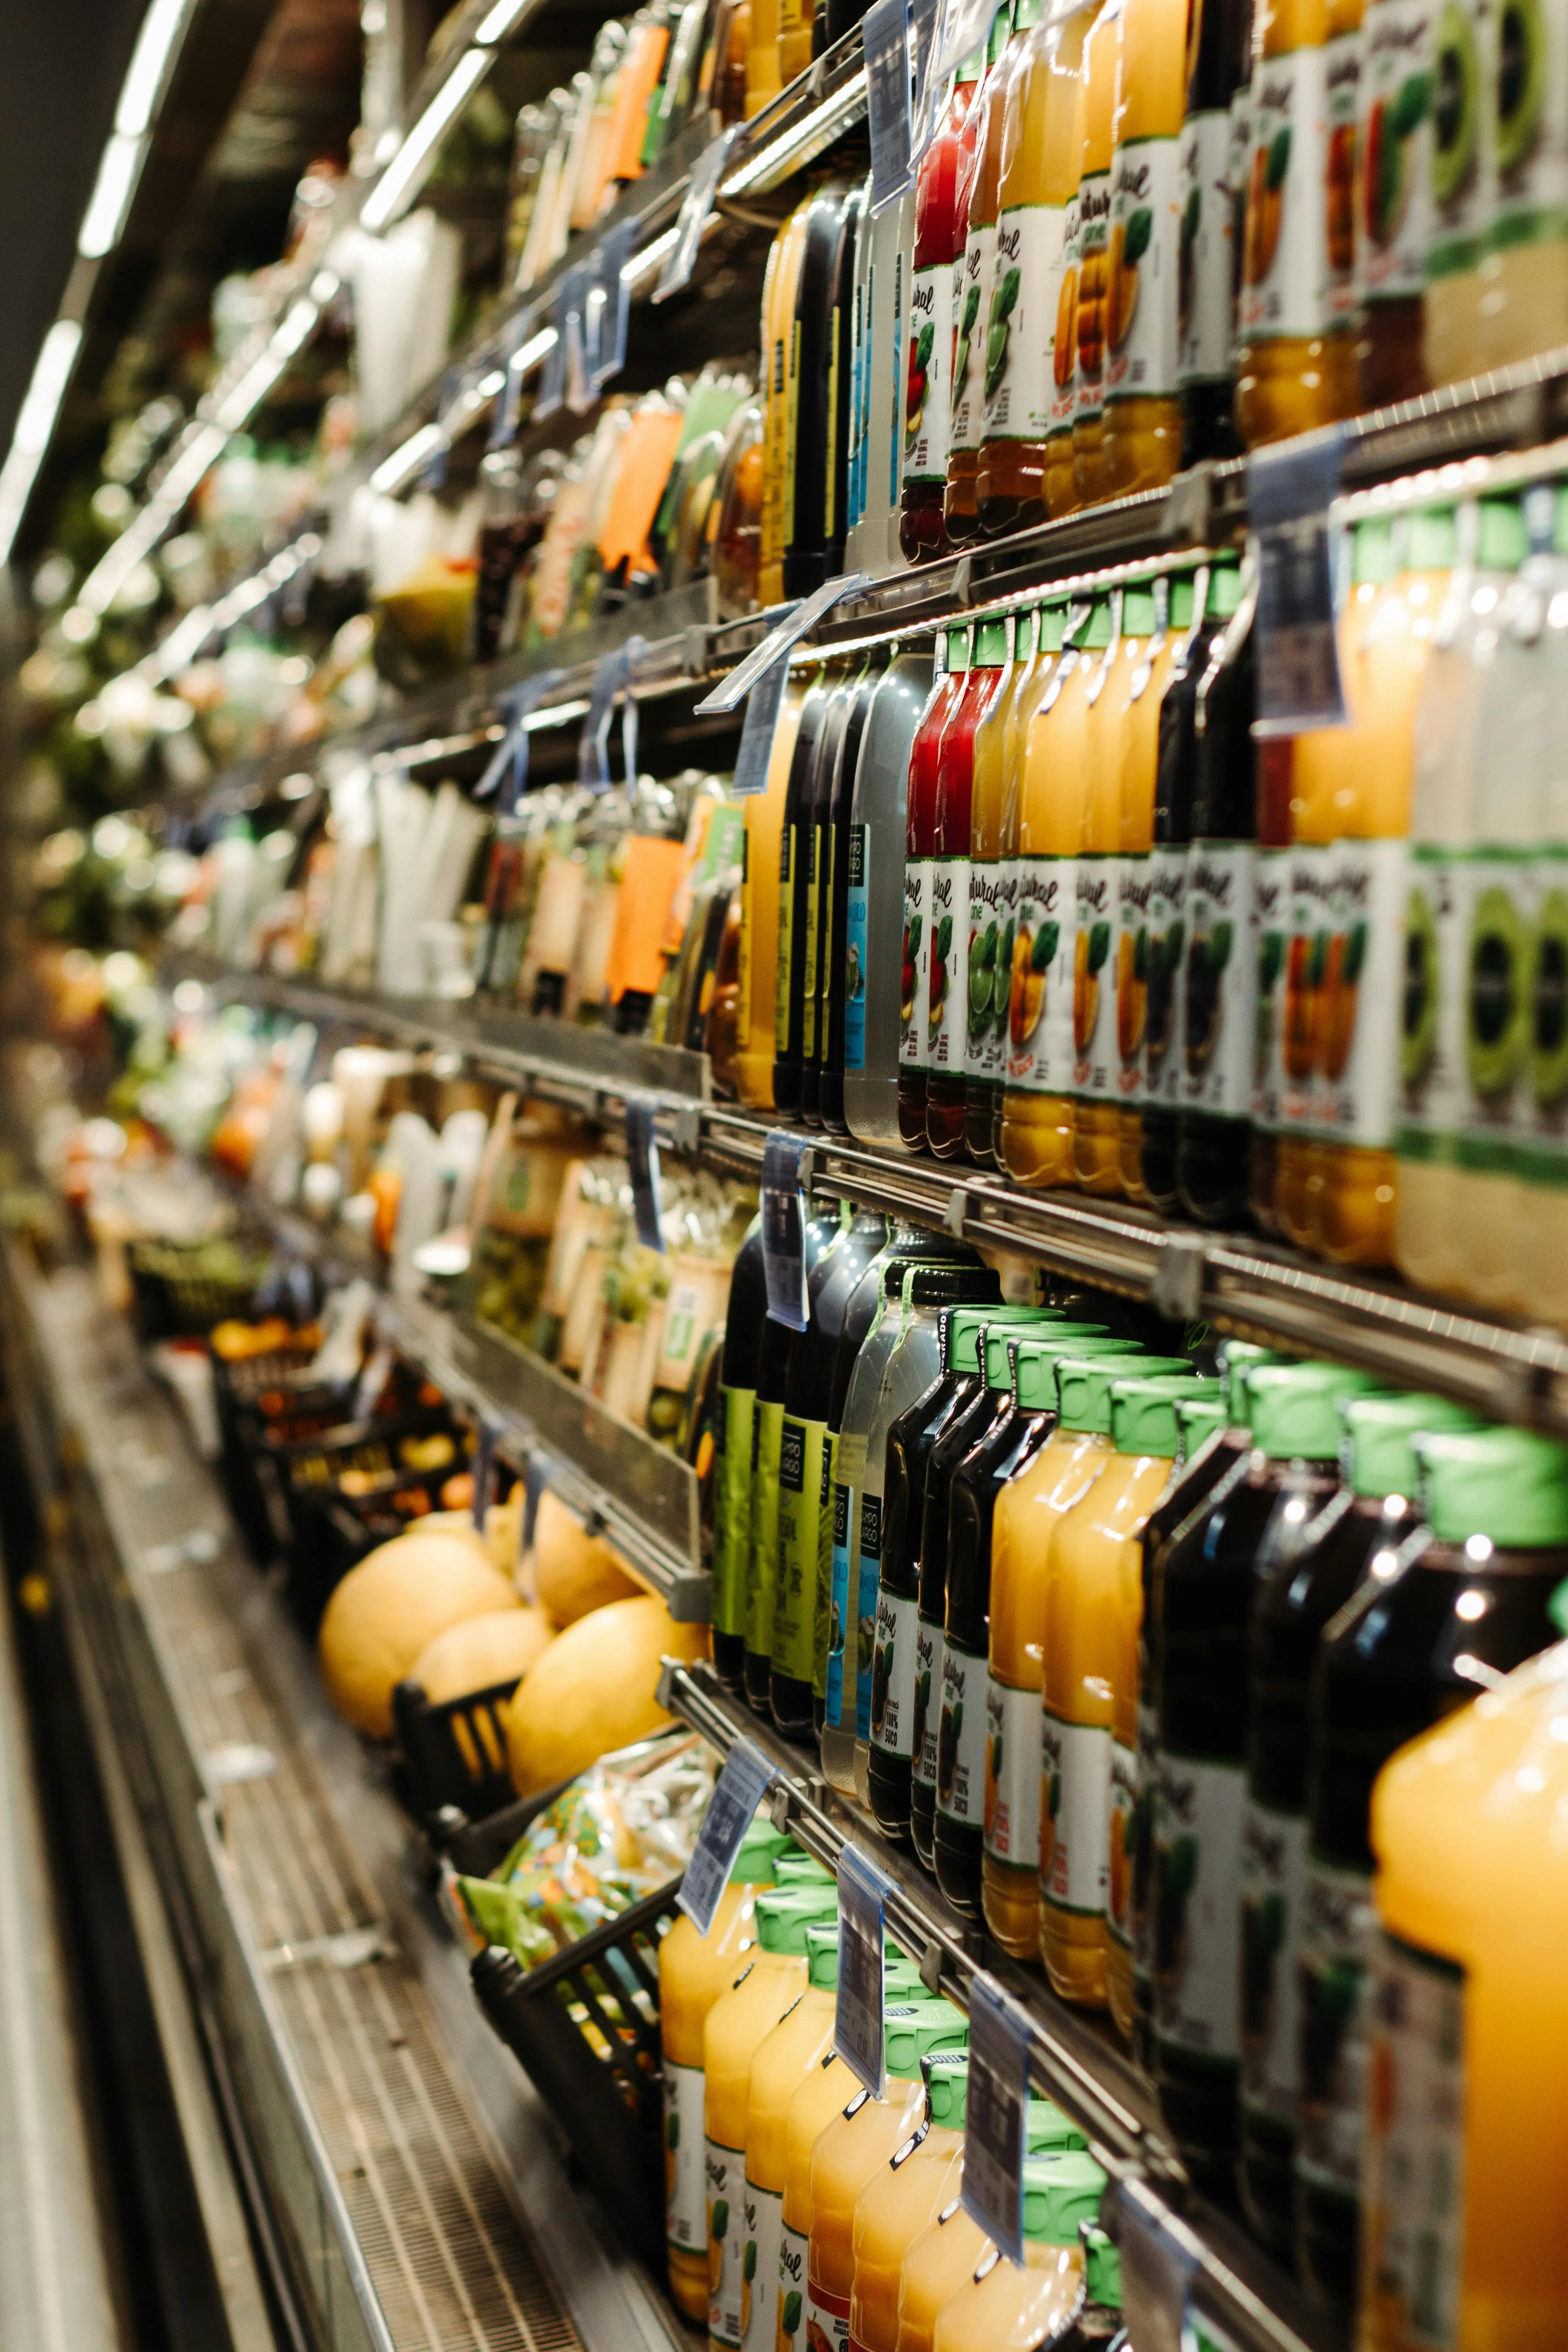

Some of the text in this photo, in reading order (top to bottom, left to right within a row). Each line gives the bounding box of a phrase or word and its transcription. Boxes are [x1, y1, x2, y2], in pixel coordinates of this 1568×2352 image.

[886, 1711, 898, 1730] 100%
[885, 1728, 897, 1747] SUCO
[924, 1760, 936, 1780] SUCO
